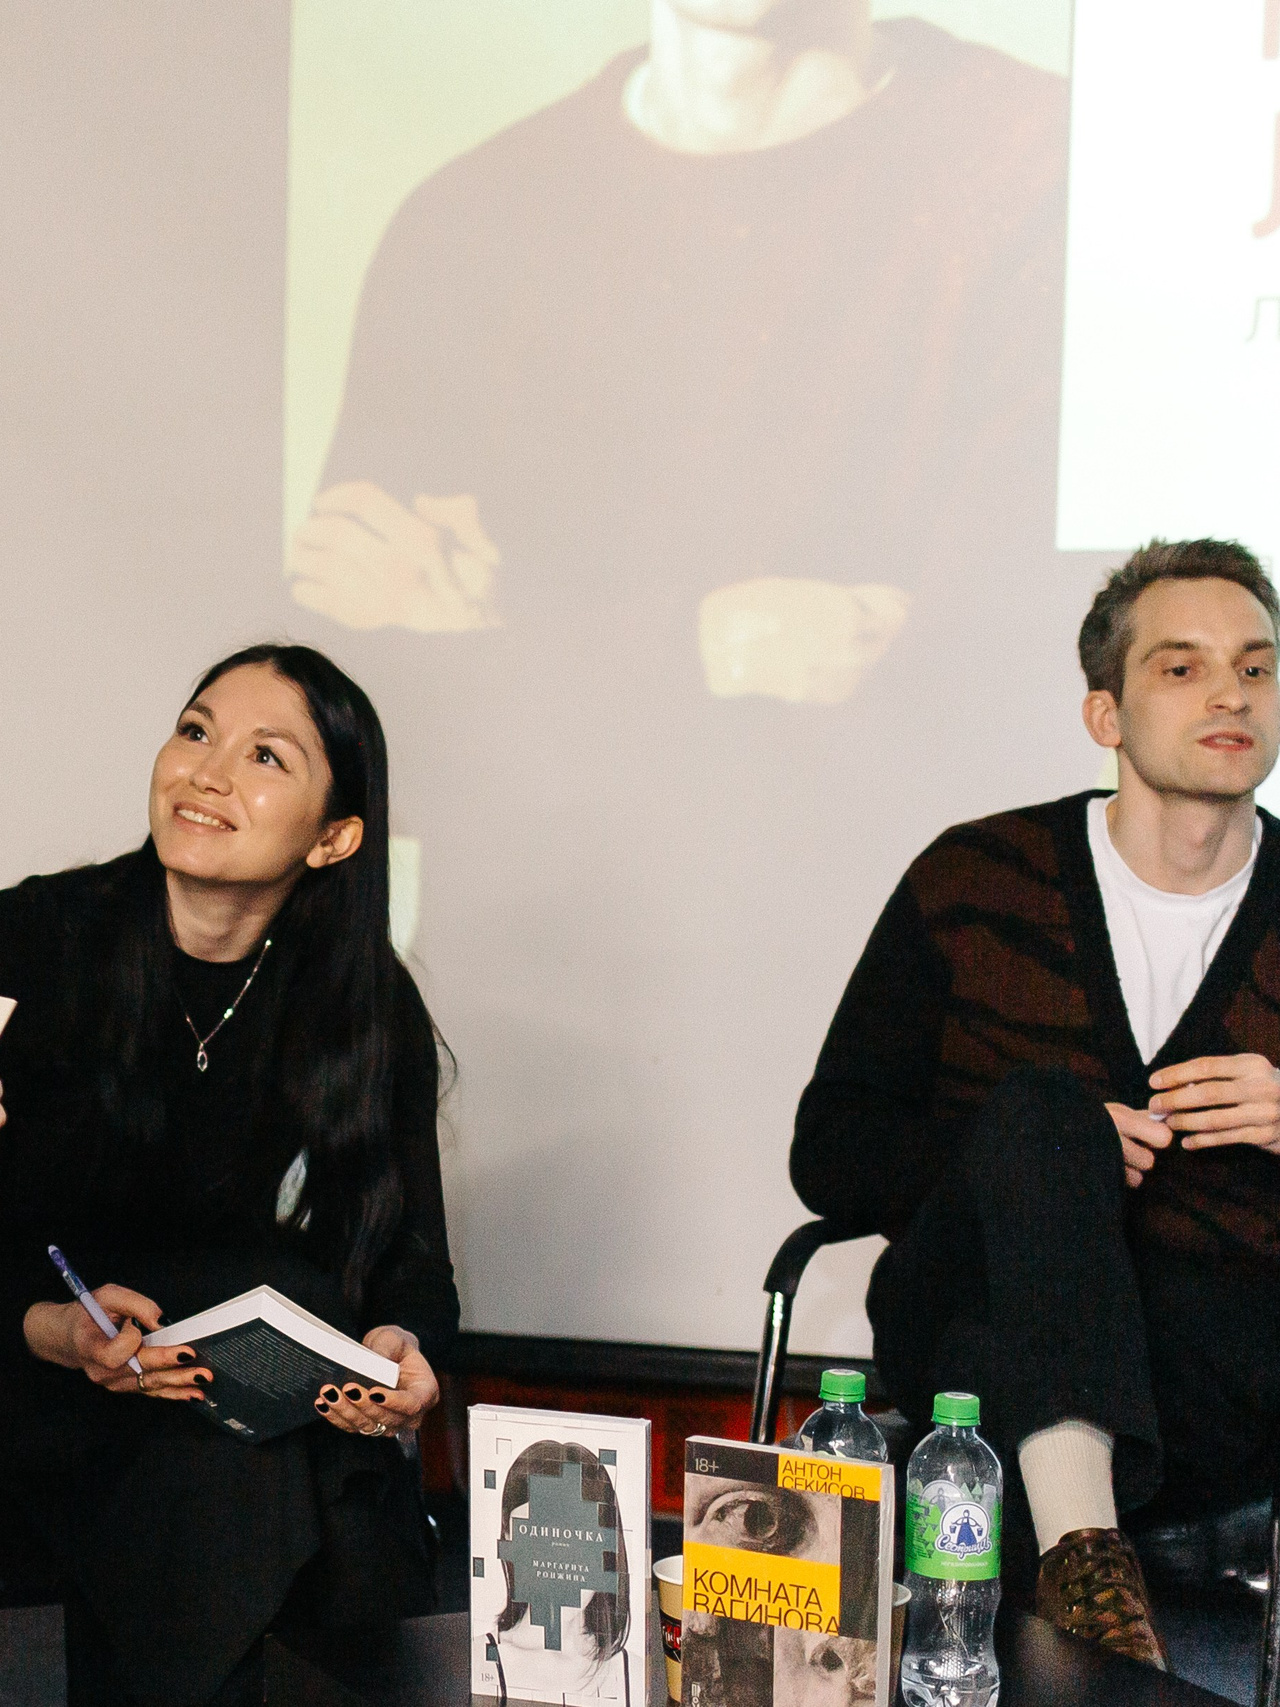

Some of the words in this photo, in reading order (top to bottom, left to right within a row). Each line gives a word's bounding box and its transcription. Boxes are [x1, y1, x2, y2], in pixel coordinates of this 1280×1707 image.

[695, 1457, 720, 1473] 18+
[782, 1459, 842, 1482] АНТОН
[518, 1524, 604, 1542] ОДИНОЧКА
[532, 1559, 590, 1573] МАРГАРИТА
[536, 1570, 587, 1582] РОНЖИНА
[693, 1567, 824, 1612] КОМНАТА
[693, 1592, 840, 1636] ВАГИНОВА
[480, 1672, 495, 1682] 18+
